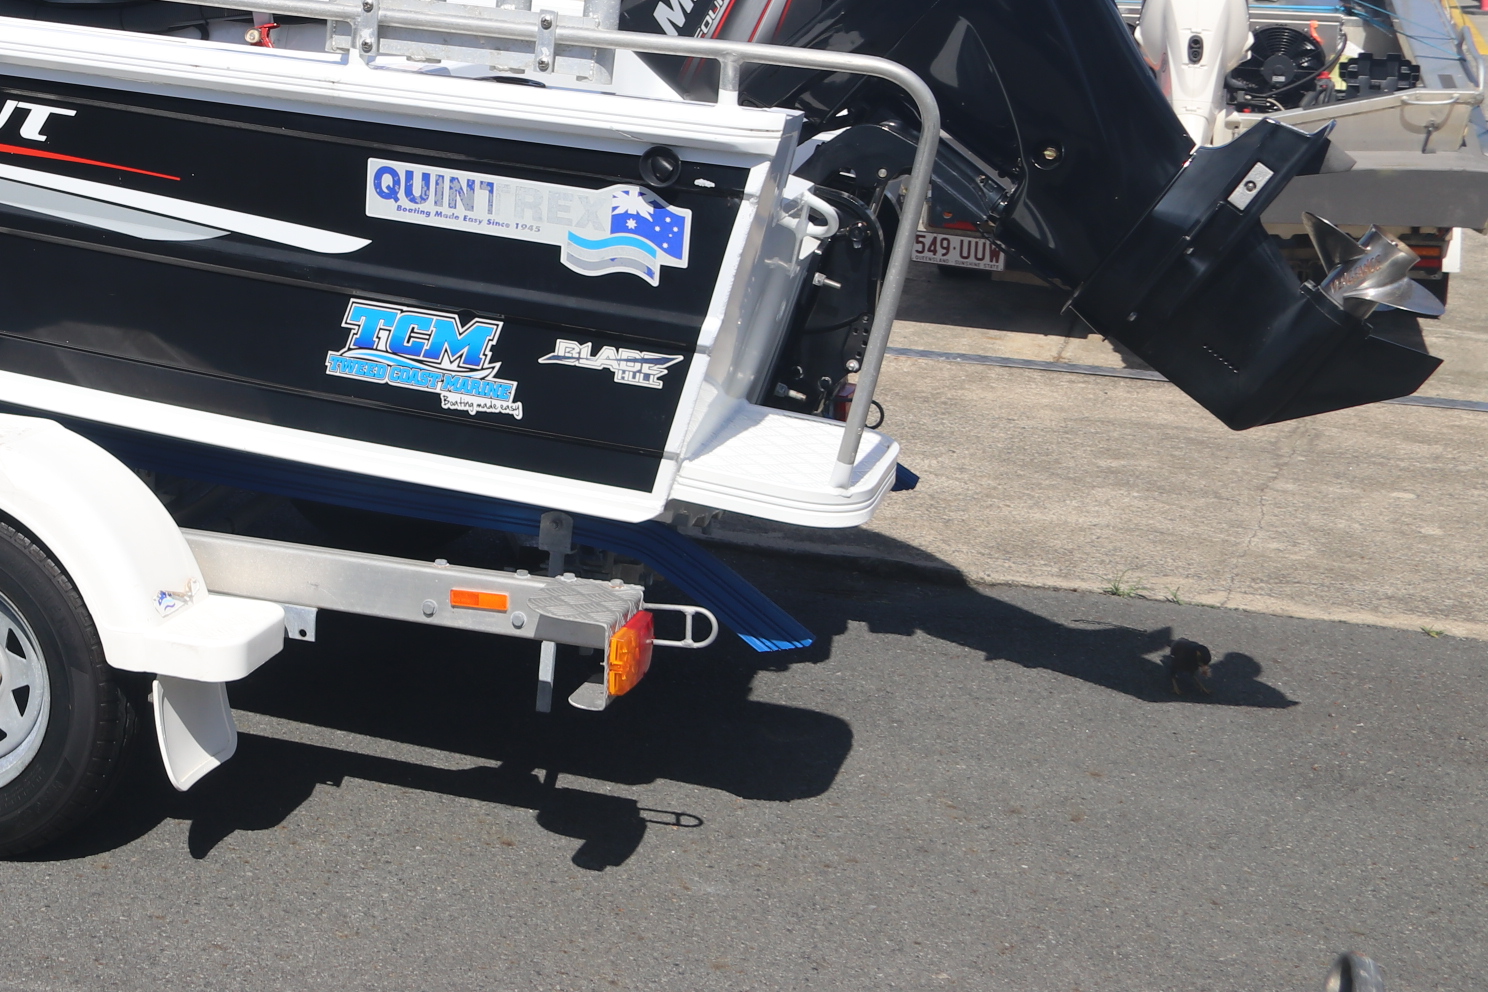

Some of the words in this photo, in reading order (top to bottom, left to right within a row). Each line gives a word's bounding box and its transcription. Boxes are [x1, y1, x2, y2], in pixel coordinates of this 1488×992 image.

[373, 166, 606, 232] QUINTREX
[396, 205, 431, 218] Boating
[434, 210, 460, 221] Made
[463, 215, 484, 226] Easy
[486, 218, 510, 229] Since
[515, 222, 541, 233] 1945
[348, 305, 496, 367] TCM
[555, 339, 680, 374] BLADE
[329, 355, 387, 379] TWEED
[388, 365, 441, 389] COAST
[441, 374, 513, 400] MARINE
[616, 370, 662, 387] HULL
[442, 395, 474, 412] Boating
[476, 401, 498, 410] made
[500, 404, 520, 417] easy
